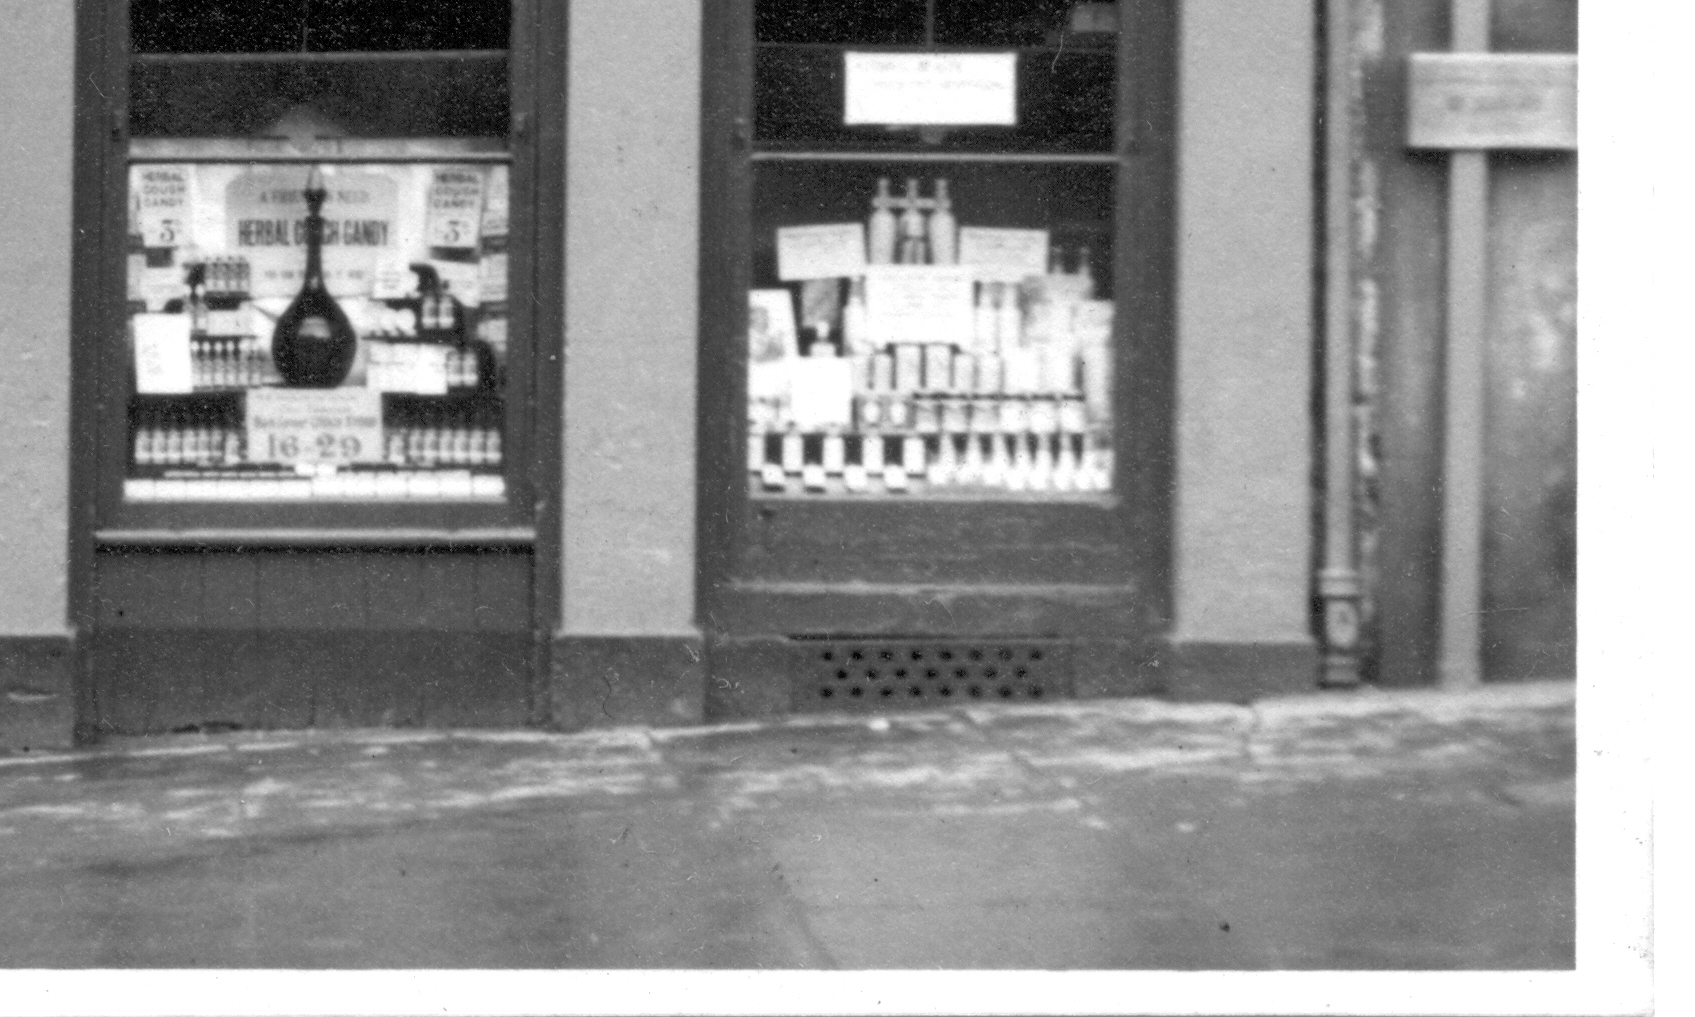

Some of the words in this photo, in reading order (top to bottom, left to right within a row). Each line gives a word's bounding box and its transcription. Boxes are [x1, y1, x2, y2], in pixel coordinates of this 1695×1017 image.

[237, 219, 290, 246] HERBAL
[293, 219, 340, 246] CGH
[343, 220, 389, 246] CANDY
